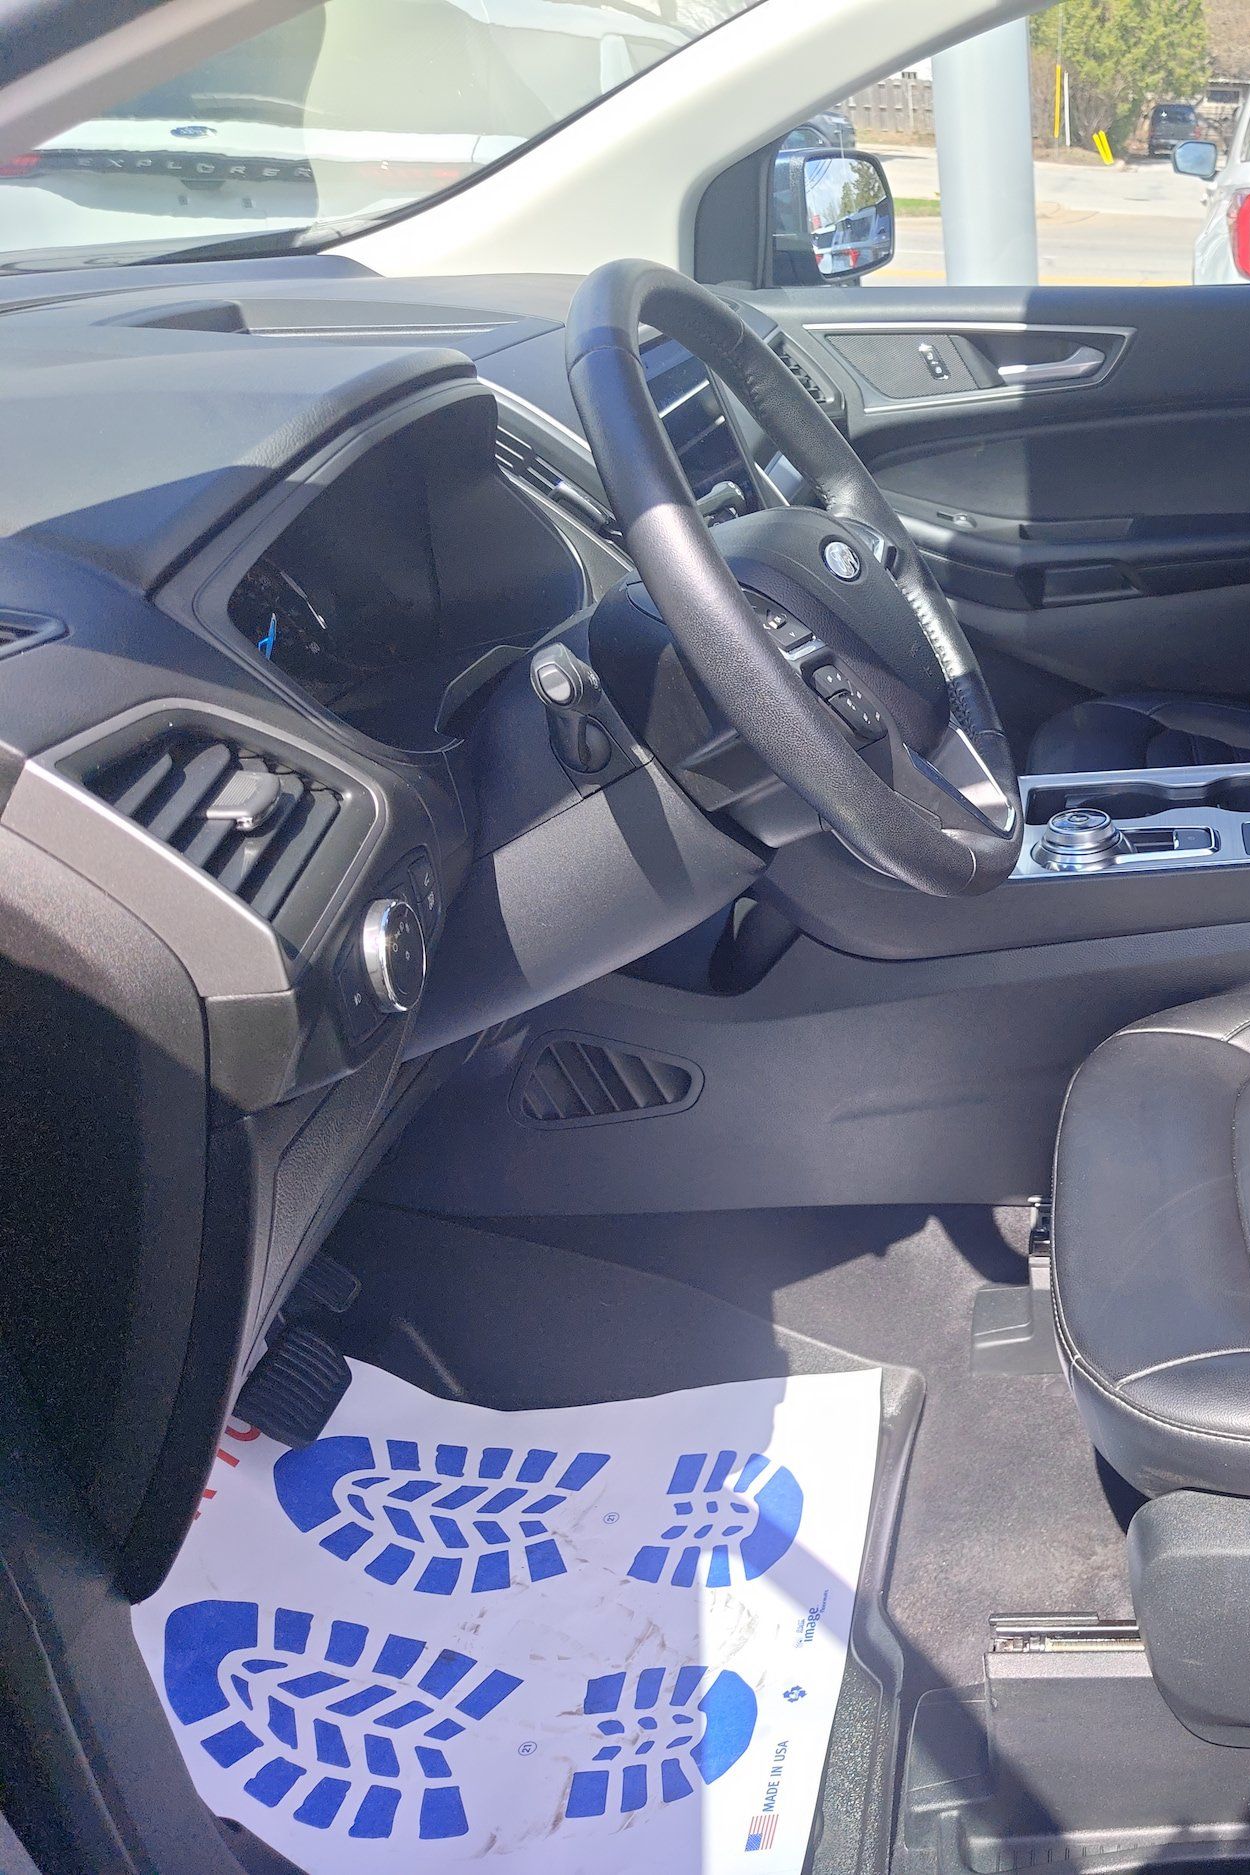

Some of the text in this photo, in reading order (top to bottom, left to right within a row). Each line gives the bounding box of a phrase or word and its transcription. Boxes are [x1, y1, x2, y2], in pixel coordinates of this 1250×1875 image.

[77, 157, 312, 178] EXPLORER
[804, 1606, 821, 1643] image
[762, 1740, 789, 1813] MADE IN USA
